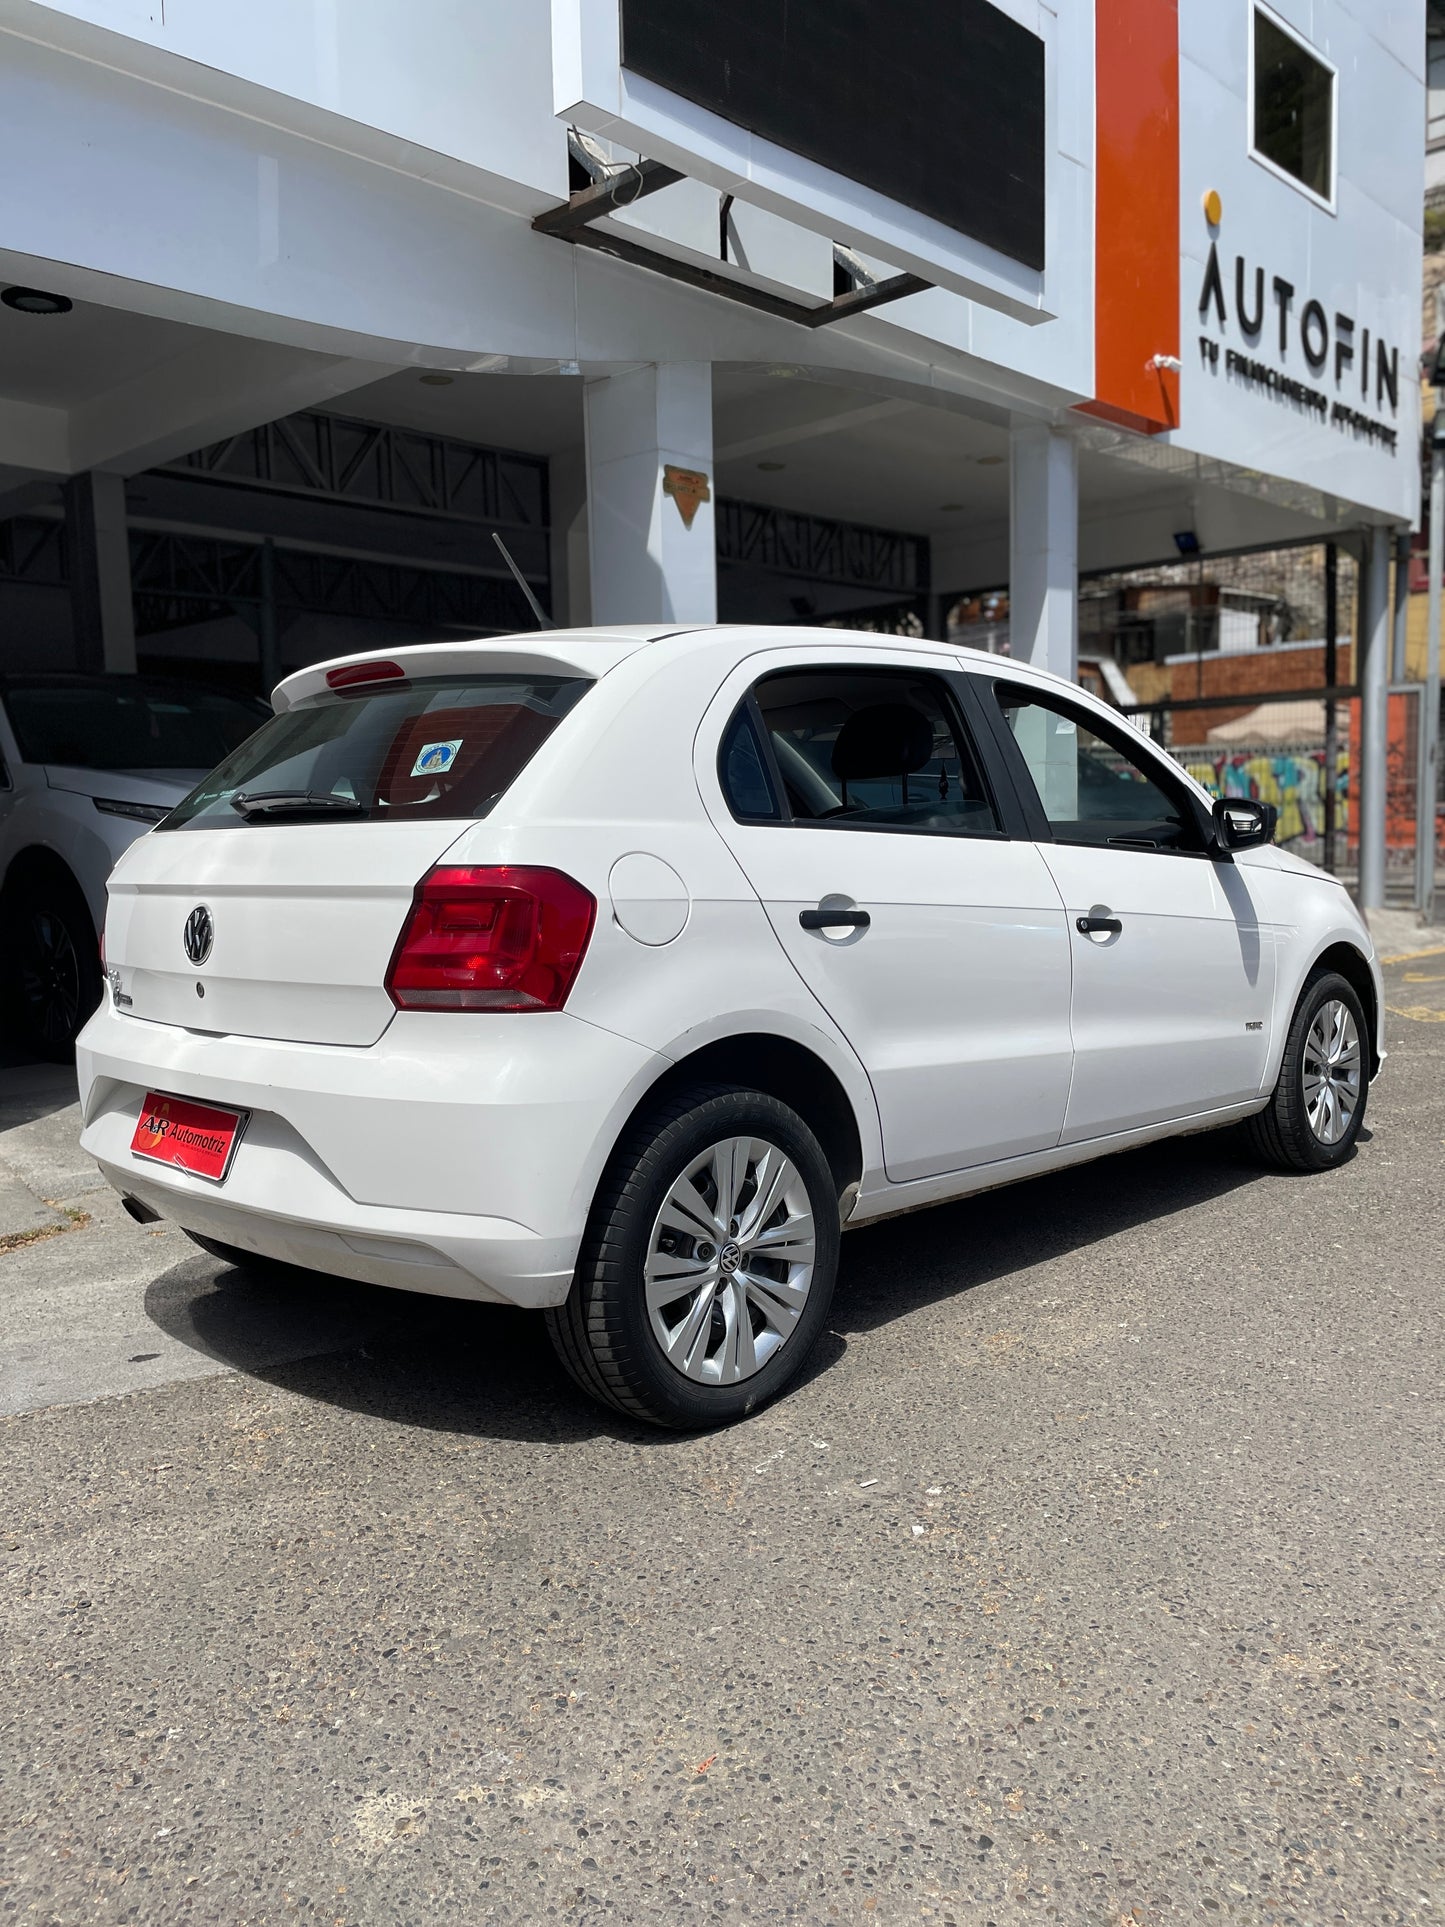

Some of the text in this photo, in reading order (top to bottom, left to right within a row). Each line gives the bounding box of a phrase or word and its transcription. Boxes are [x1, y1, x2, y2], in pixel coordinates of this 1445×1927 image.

[1198, 240, 1399, 413] AUTOFIN
[1199, 336, 1219, 364] TU
[169, 1123, 226, 1154] Automotriz
